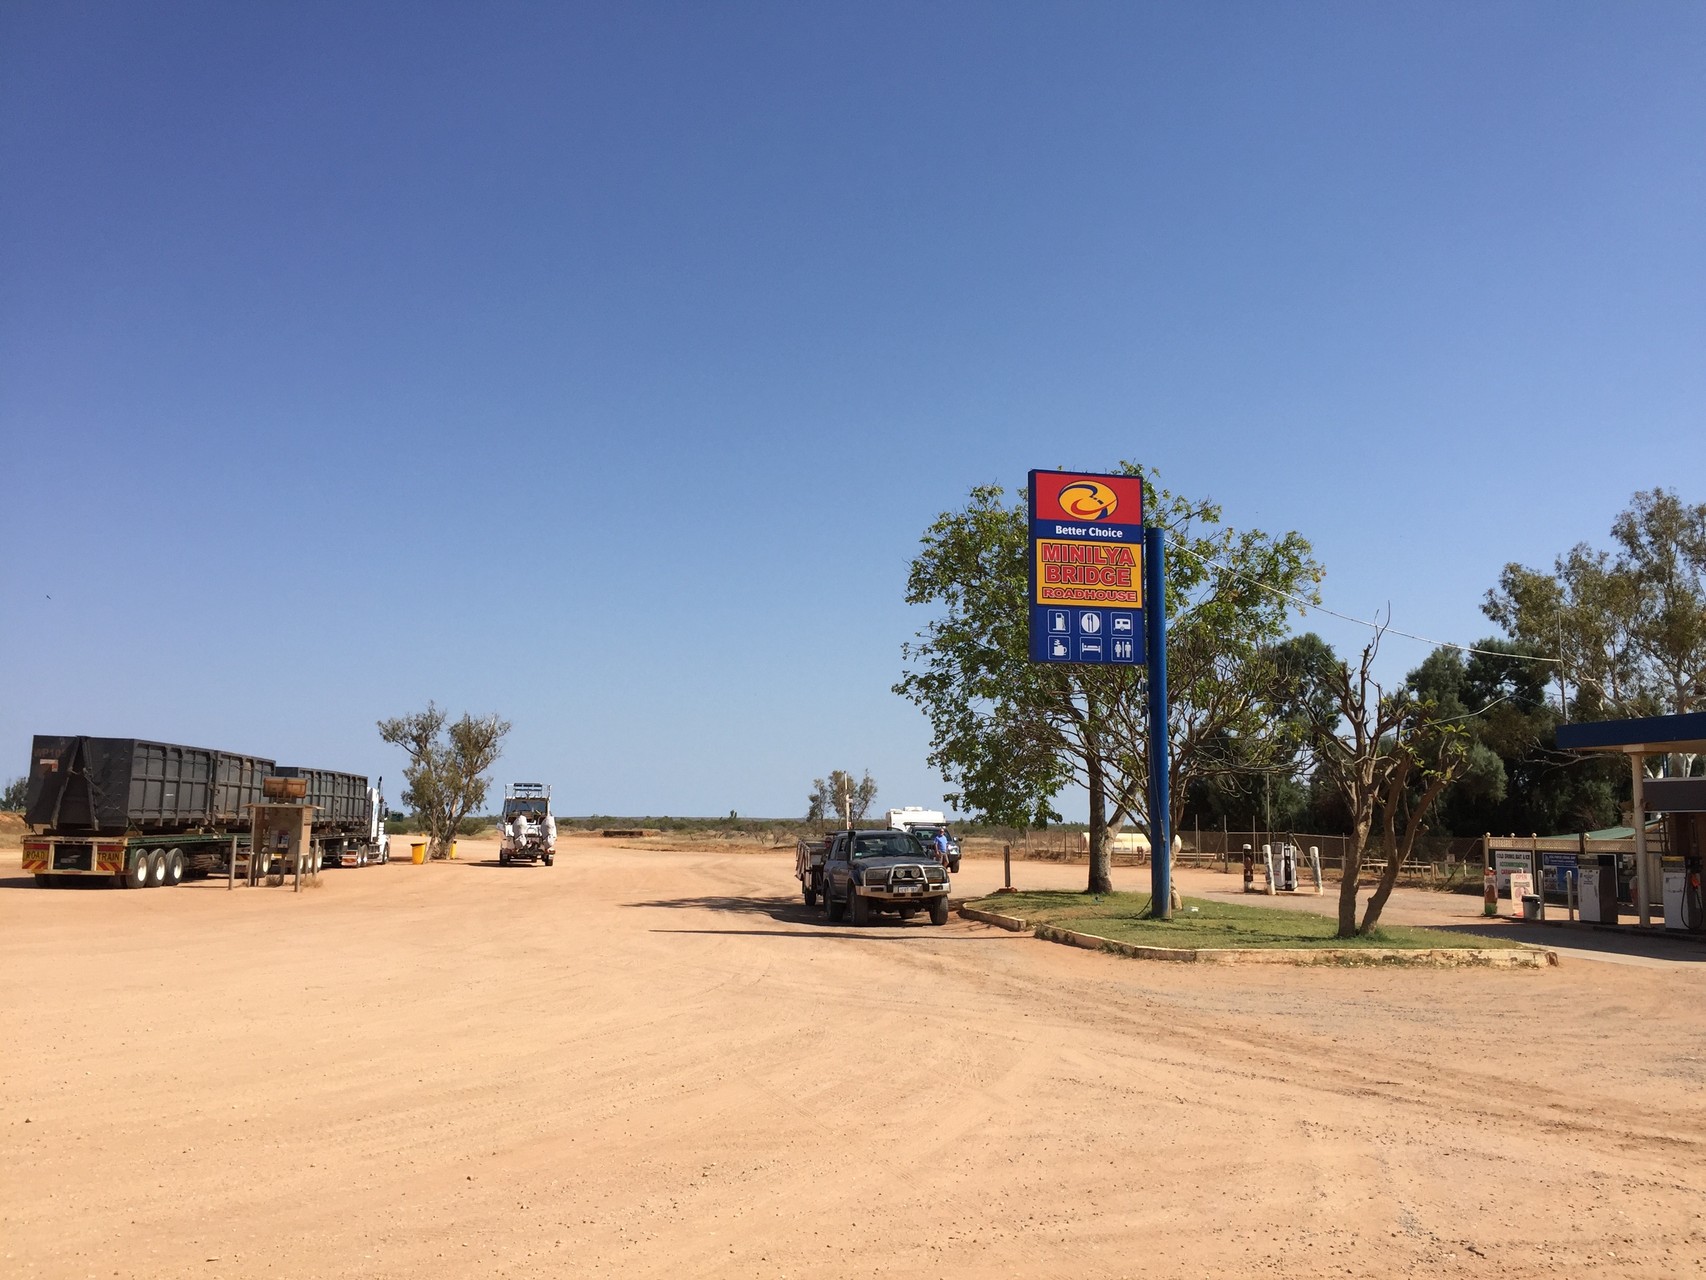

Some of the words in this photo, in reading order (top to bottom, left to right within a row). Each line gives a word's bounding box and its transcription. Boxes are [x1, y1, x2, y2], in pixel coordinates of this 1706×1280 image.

[1056, 525, 1087, 536] Better
[1088, 527, 1123, 538] Choice
[1042, 542, 1136, 567] MINILYA
[1045, 564, 1131, 587] BRIDGE
[1042, 587, 1137, 602] ROADHOUSE
[26, 850, 45, 861] ROAD
[97, 852, 120, 862] TRAIN
